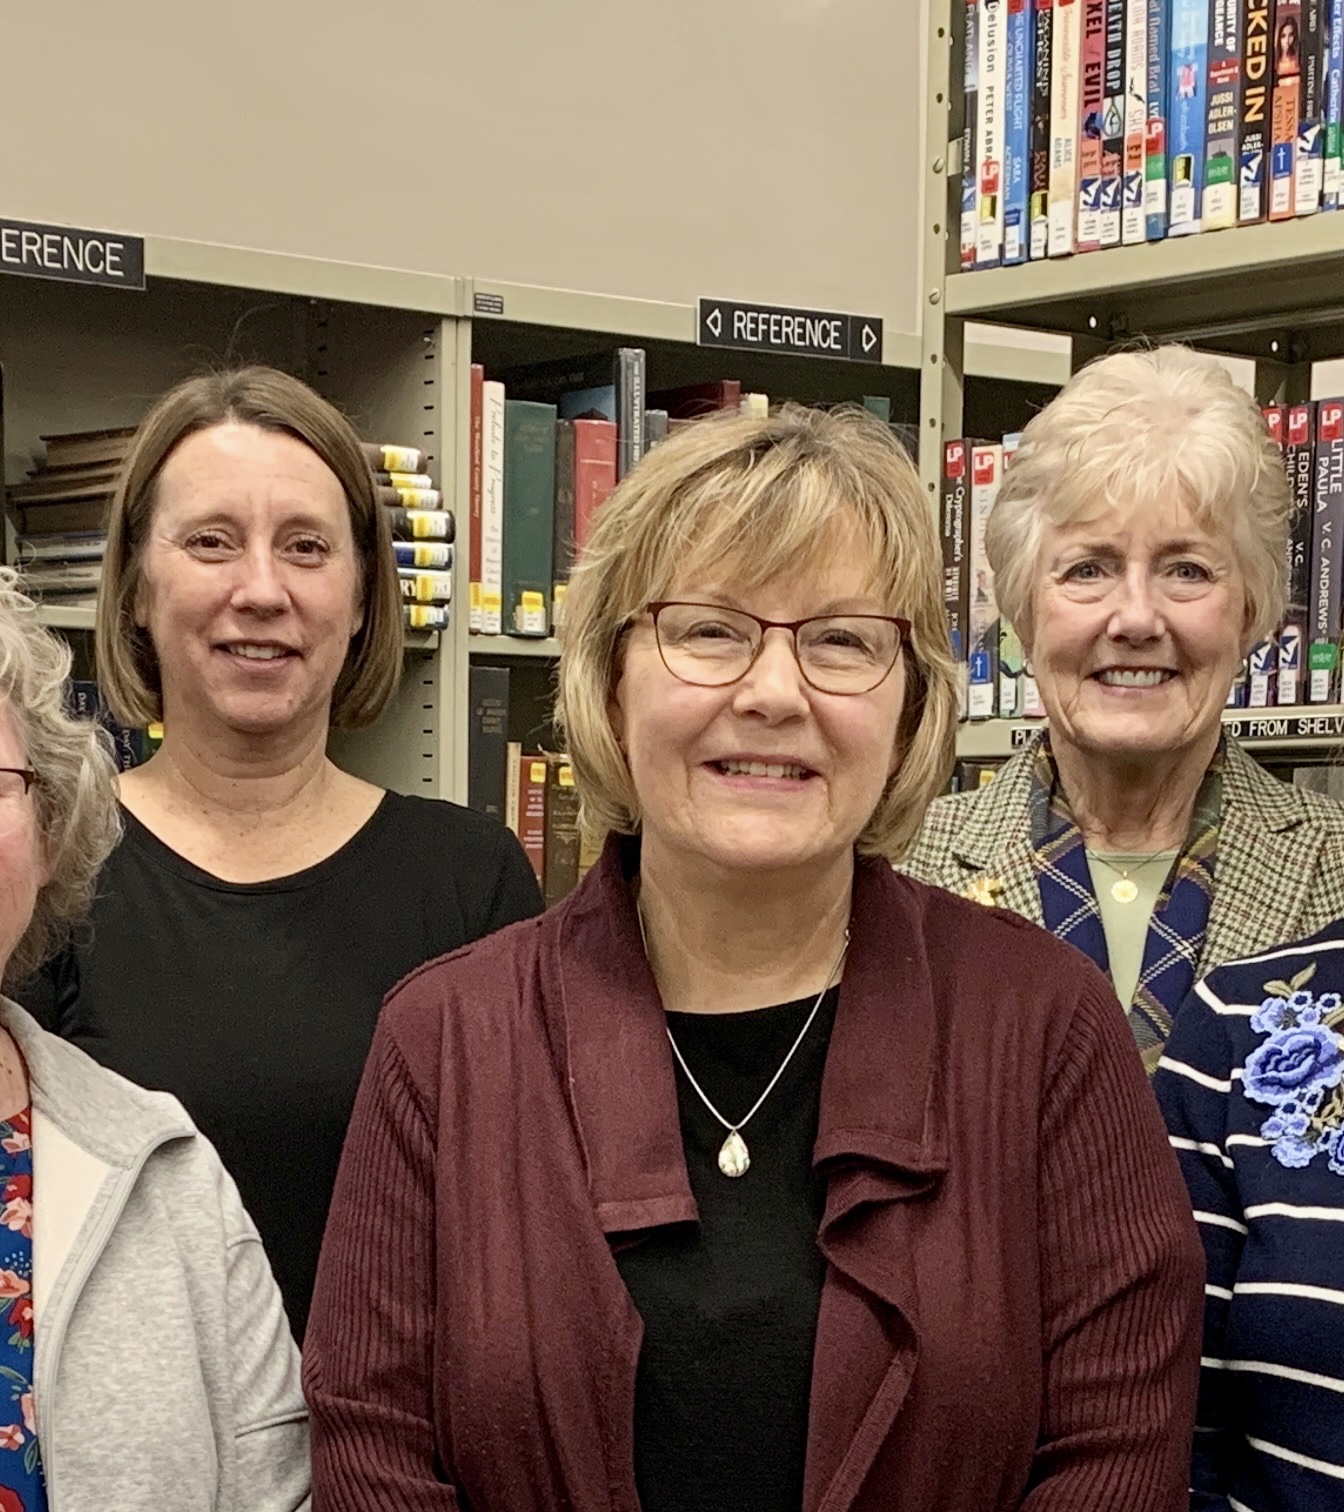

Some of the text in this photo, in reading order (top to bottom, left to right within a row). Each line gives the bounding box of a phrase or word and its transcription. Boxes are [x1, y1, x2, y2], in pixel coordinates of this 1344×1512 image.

[1208, 106, 1237, 121] ADLER-
[1211, 91, 1234, 106] JUSSI
[1244, 85, 1265, 124] IN
[1208, 119, 1235, 135] OLSEN
[733, 310, 842, 350] REFERENCE
[1321, 407, 1342, 428] LP
[1329, 438, 1343, 494] LITTLE
[1315, 456, 1329, 513] PAULA
[1316, 556, 1330, 630] ANDREWS
[1249, 719, 1288, 736] FROM
